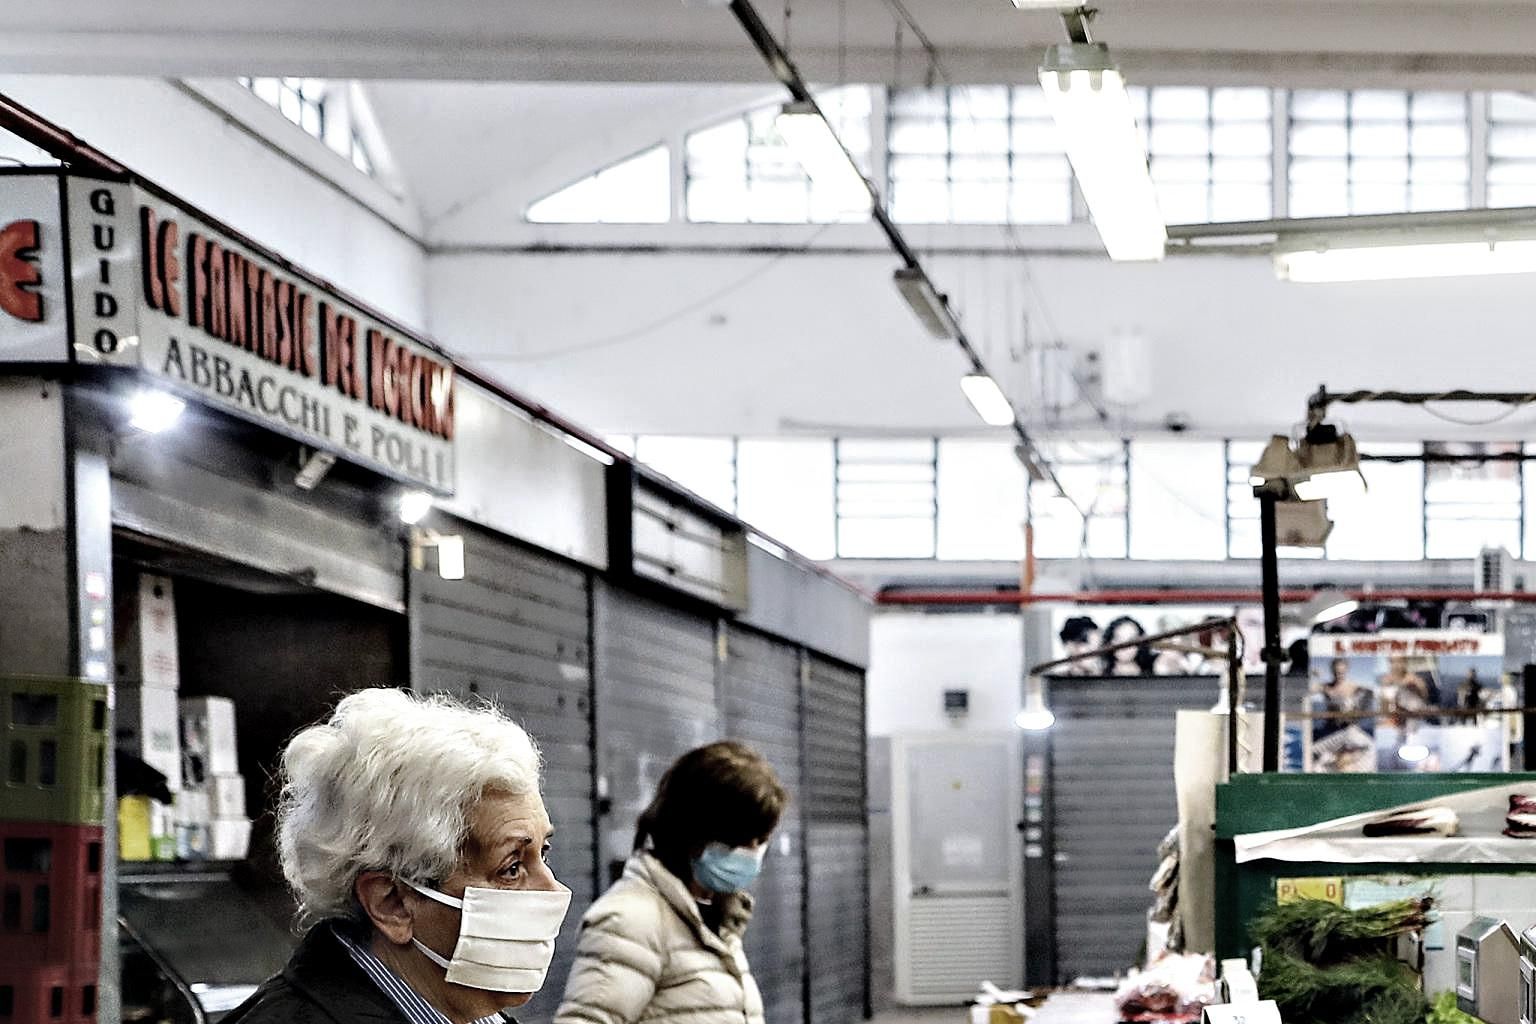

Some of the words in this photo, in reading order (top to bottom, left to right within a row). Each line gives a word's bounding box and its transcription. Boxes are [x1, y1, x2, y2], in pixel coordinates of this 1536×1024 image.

[90, 189, 118, 353] GUIDO
[140, 206, 180, 317] LE
[187, 233, 315, 377] FANTASIE
[319, 302, 364, 400] DEL
[164, 337, 331, 436] ABBACCHI
[345, 414, 360, 449] E
[371, 424, 444, 486] POLLI
